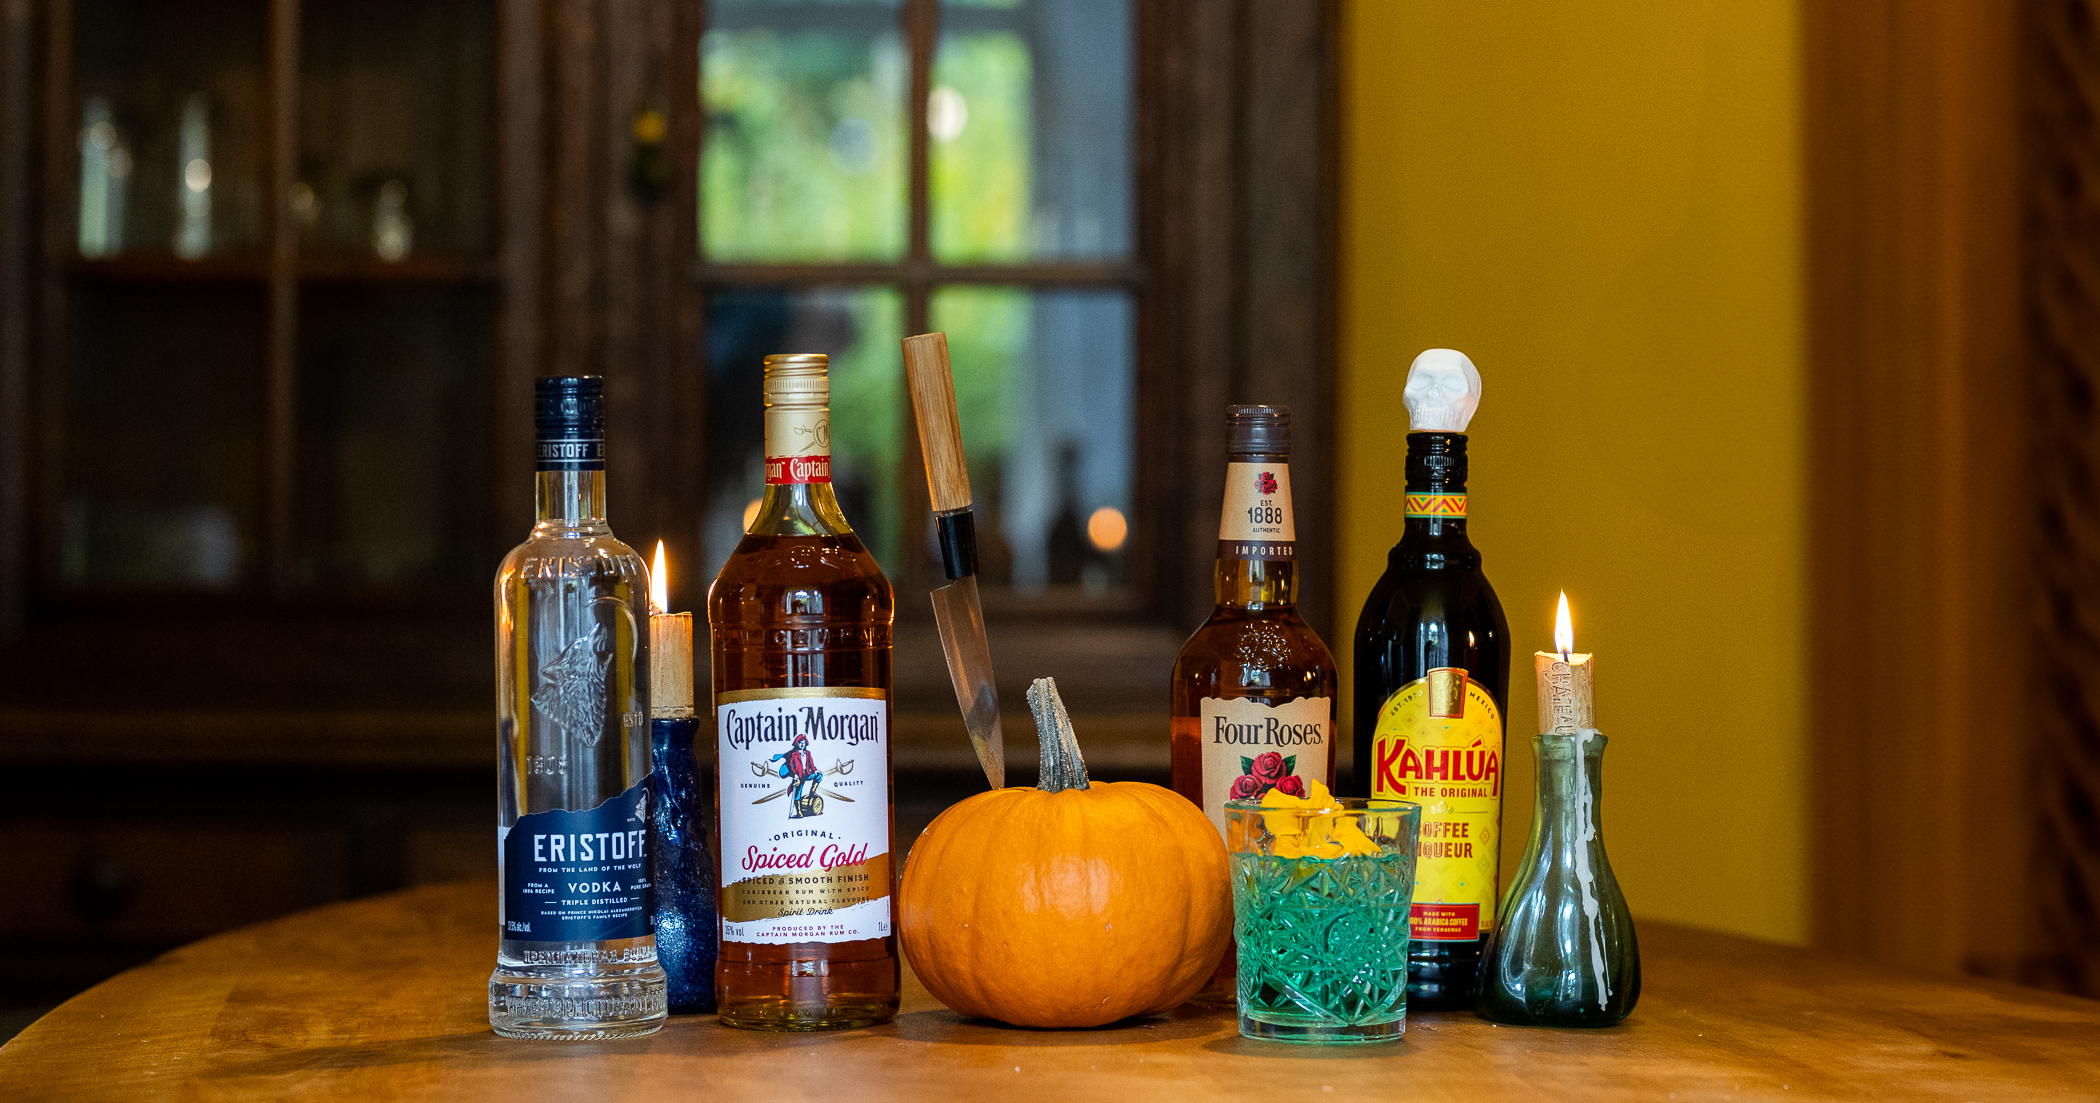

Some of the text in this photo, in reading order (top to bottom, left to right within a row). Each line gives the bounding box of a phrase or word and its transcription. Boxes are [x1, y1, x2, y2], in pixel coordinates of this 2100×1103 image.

[537, 443, 590, 459] ERISTOFF
[789, 458, 829, 481] Captain
[1247, 506, 1282, 525] 1888
[1235, 545, 1293, 556] IMPORTED
[1469, 691, 1495, 719] MEXICO
[1551, 661, 1574, 736] CHATEAU
[726, 706, 879, 751] Captain Morgan
[1213, 716, 1322, 747] Four Roses
[1376, 739, 1499, 797] KAHLÚA
[833, 780, 864, 788] QUALITY
[1413, 787, 1488, 798] THE ORIGINAL
[773, 829, 834, 841] ORIGINAL
[533, 829, 647, 862] ERISTOFF
[1417, 842, 1473, 859] IQUEUR
[741, 843, 869, 873] Spiced Gold
[567, 881, 622, 894] VODKA
[742, 877, 775, 885] SPICED
[837, 874, 869, 883] FINISH
[591, 897, 628, 905] DISTILLED
[831, 896, 870, 904] FLAVOURS
[777, 906, 834, 917] Spirit Drink
[1408, 916, 1468, 926] 00% ARABICA COFFEE
